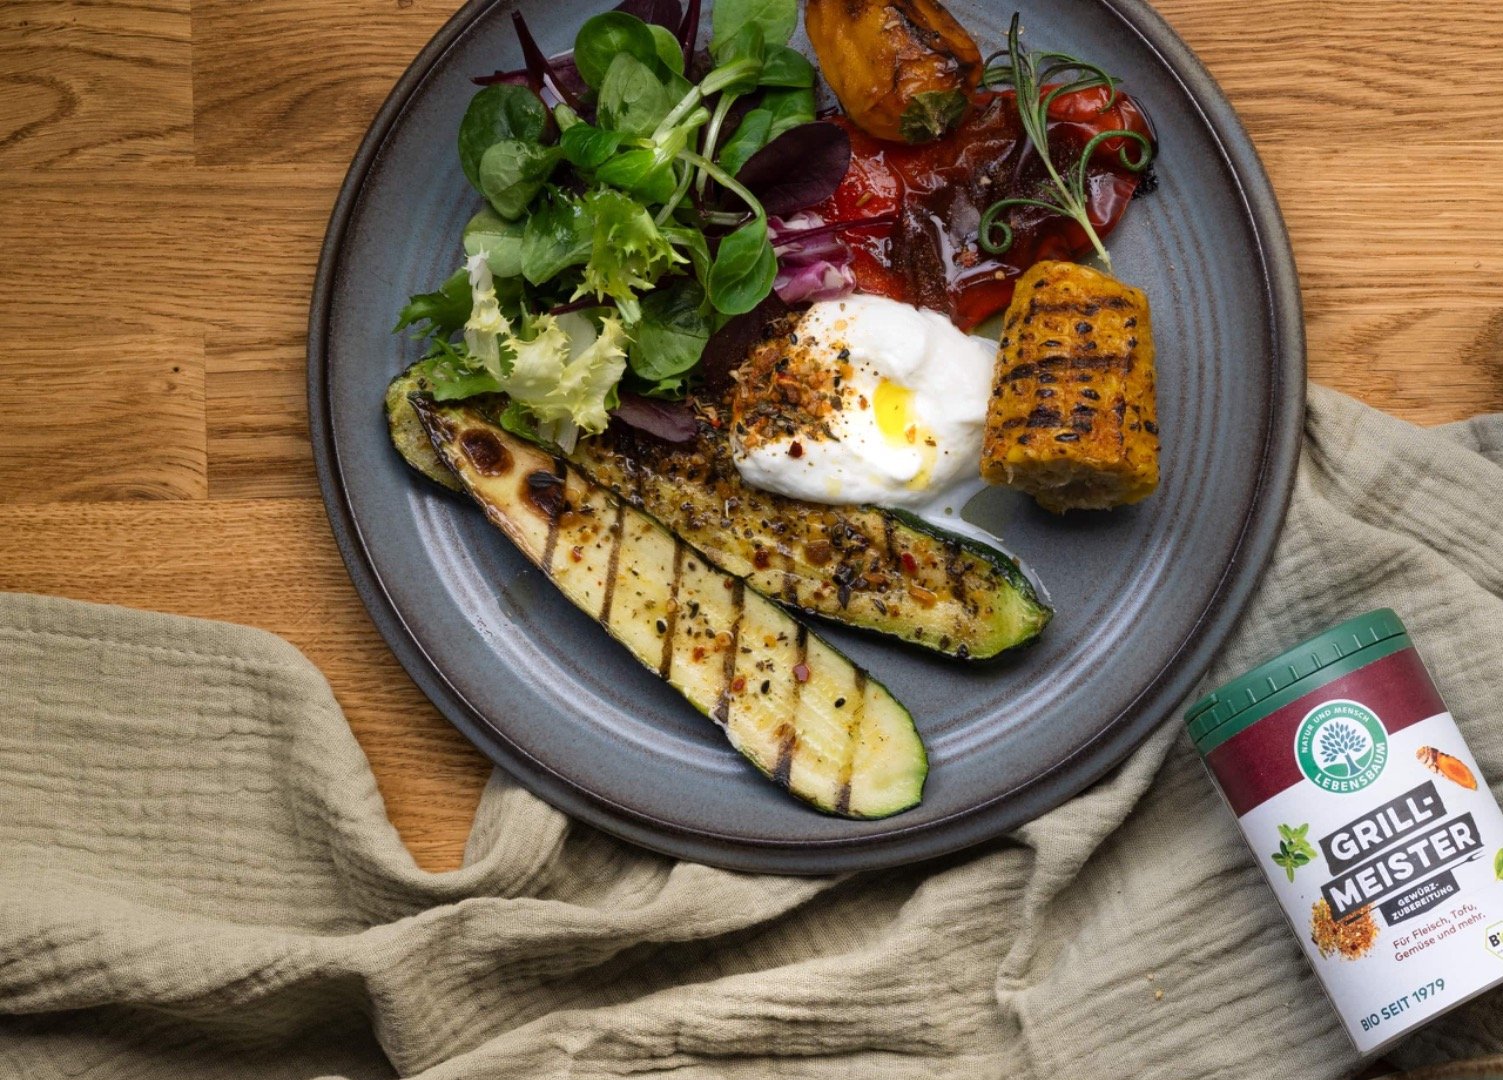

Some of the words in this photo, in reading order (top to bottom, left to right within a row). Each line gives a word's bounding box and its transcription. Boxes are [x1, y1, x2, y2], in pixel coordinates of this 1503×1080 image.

[1302, 724, 1314, 753] NATUR
[1313, 710, 1331, 723] UND
[1334, 707, 1369, 722] MENSCH
[1314, 742, 1386, 791] LEBENSBAUM
[1331, 796, 1434, 861] GRILL-
[1329, 822, 1476, 913] MEISTER
[1391, 885, 1454, 920] ZUBEREITUNG
[1398, 883, 1439, 906] GEWÜRZ-
[1393, 936, 1410, 949] Für
[1412, 917, 1450, 939] Fleisch,
[1450, 904, 1477, 919] Tofu,
[1395, 937, 1435, 961] Gemüse
[1437, 926, 1456, 940] und
[1458, 912, 1486, 929] mehr.
[1361, 1013, 1380, 1031] BIO
[1381, 996, 1410, 1020] SEIT
[1412, 978, 1445, 1002] 1979
